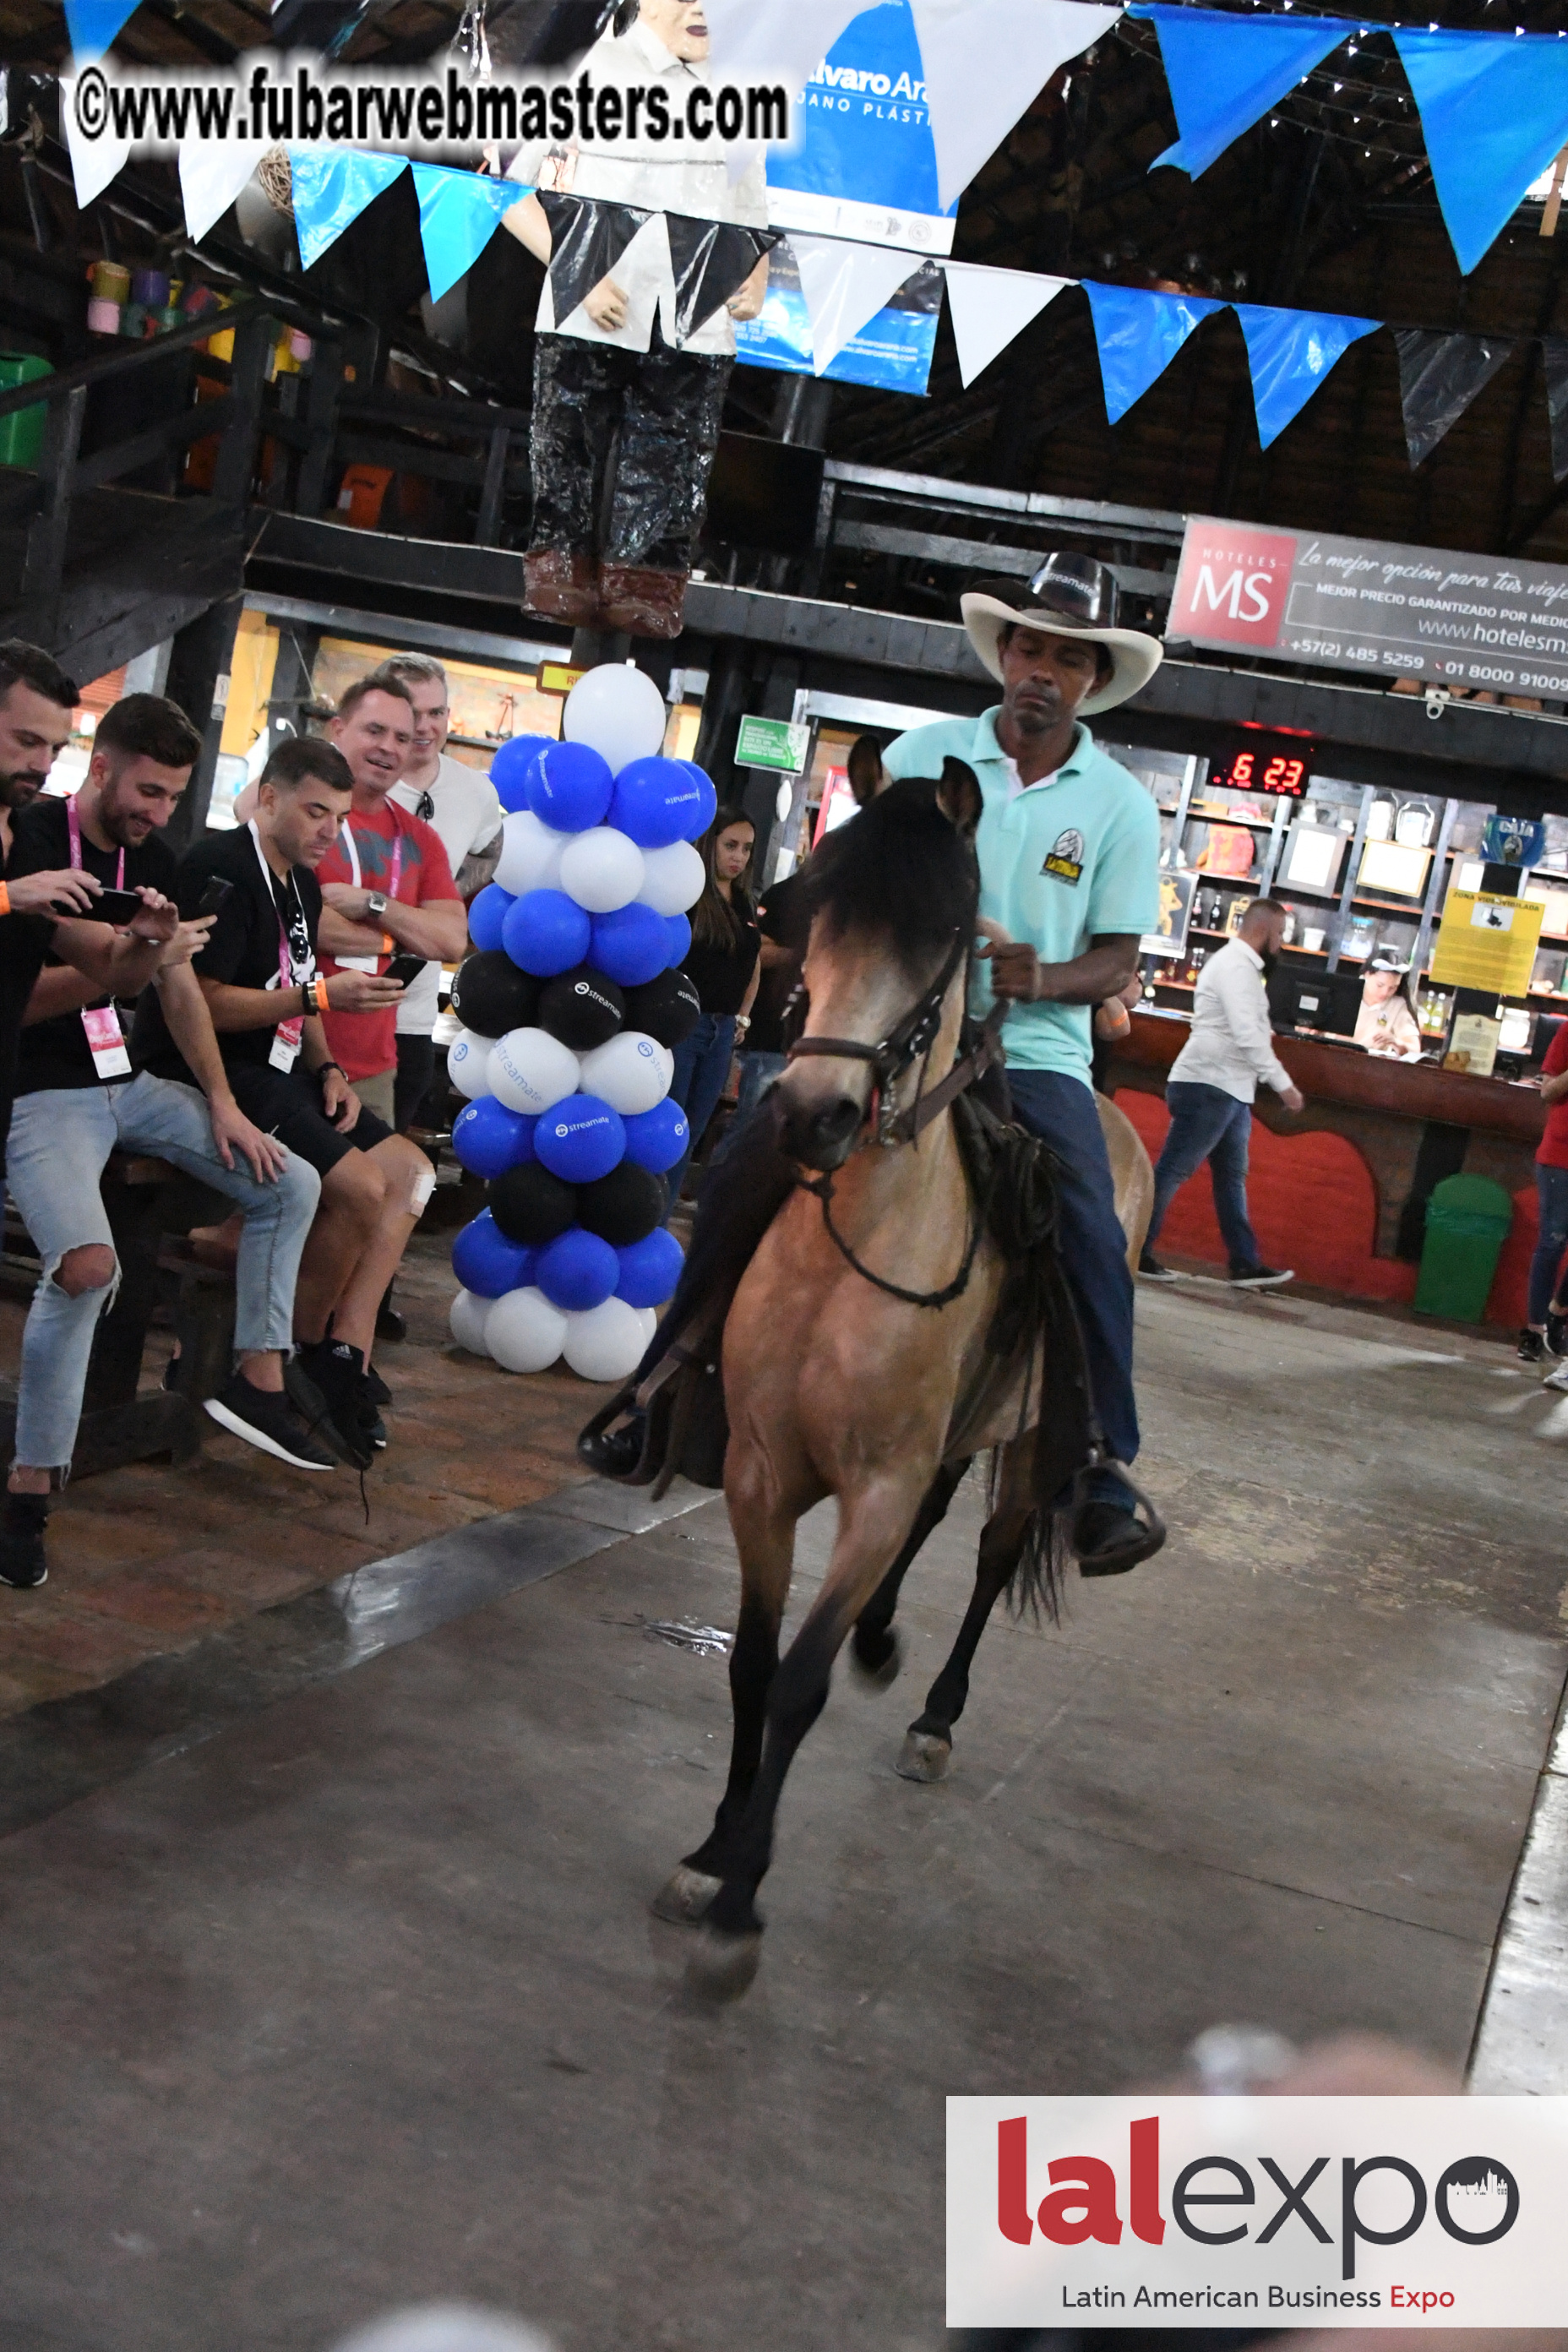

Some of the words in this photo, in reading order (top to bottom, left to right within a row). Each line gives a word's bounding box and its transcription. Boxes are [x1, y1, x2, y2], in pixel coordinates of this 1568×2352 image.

[1202, 548, 1277, 569] HOTELES
[1298, 541, 1321, 567] La
[1325, 553, 1380, 579] mejor
[1381, 562, 1443, 584] opción
[1438, 572, 1489, 591] para
[1492, 570, 1523, 593] tus
[1190, 564, 1273, 622] MS
[1315, 582, 1357, 598] MEJOR
[1360, 590, 1406, 606] PRECIO
[1407, 596, 1497, 618] GARANTIZADO
[1500, 609, 1527, 622] POR
[1291, 640, 1341, 657] +57(2)
[1346, 646, 1378, 662] 485
[1382, 651, 1425, 669] 5259
[1445, 661, 1465, 675] 01
[1468, 664, 1515, 683] 8000
[1519, 672, 1568, 692] 91009
[1499, 820, 1534, 837] CAJA
[1453, 891, 1475, 901] ZONA
[496, 1045, 543, 1102] streamate
[568, 1115, 610, 1133] streamate
